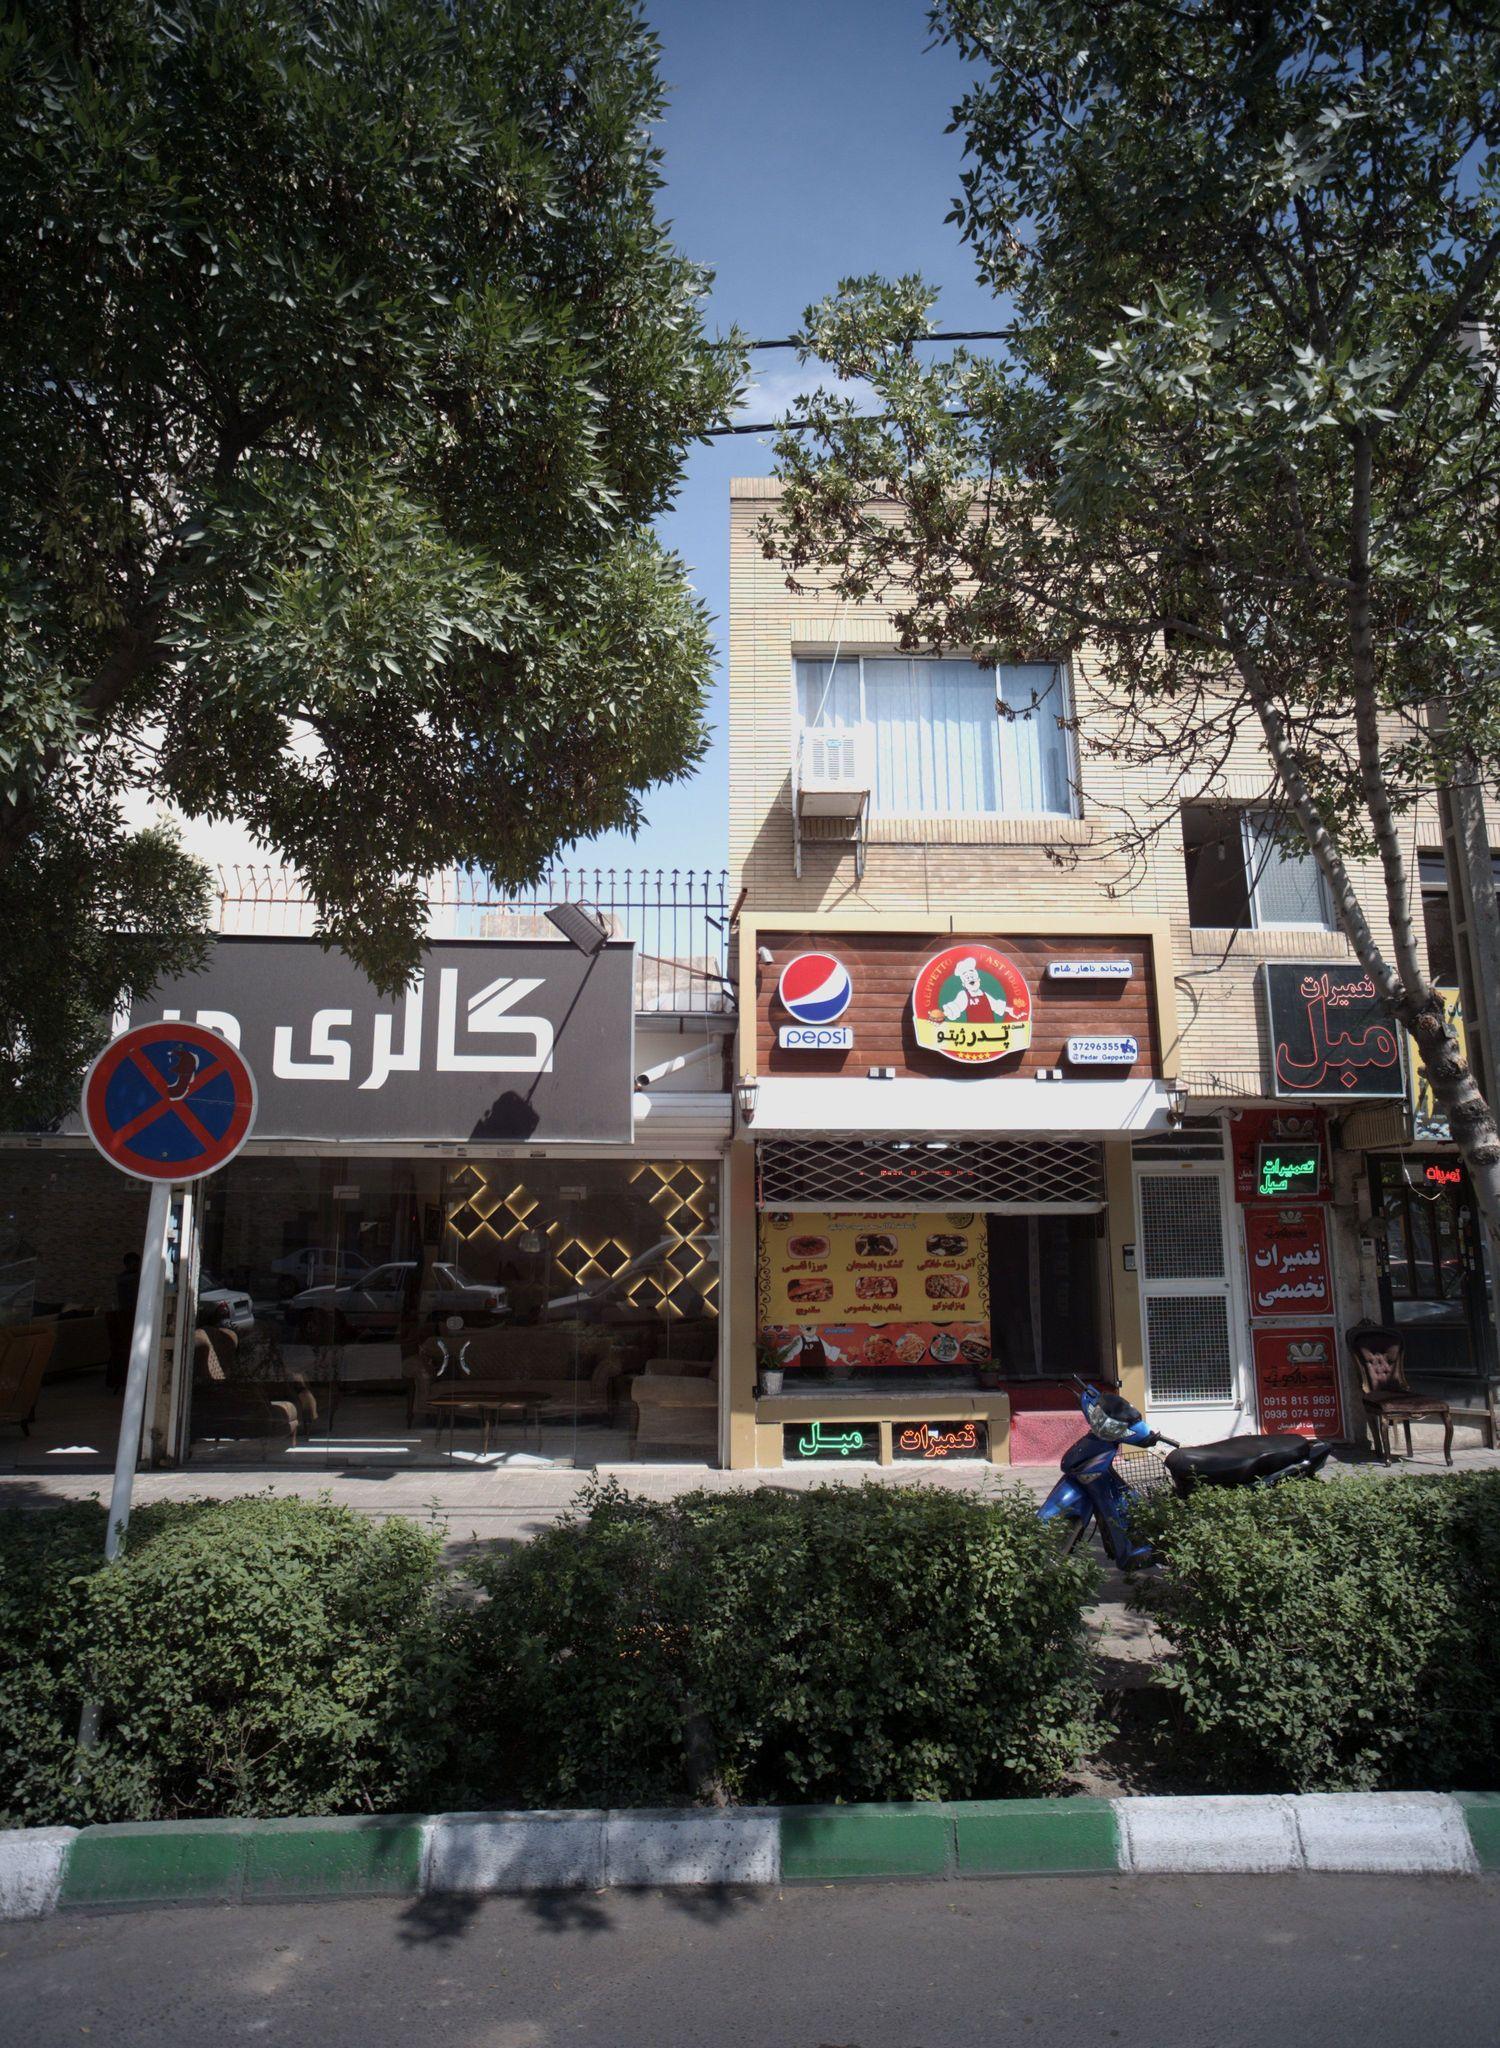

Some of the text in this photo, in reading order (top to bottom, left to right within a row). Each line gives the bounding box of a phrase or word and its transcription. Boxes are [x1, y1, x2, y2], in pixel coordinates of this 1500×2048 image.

[1054, 963, 1071, 974] شام
[1100, 964, 1130, 975] صبحانه
[272, 967, 555, 1090] گالری
[786, 1028, 848, 1049] pepsi
[1073, 1042, 1120, 1051] 37296355
[1276, 994, 1397, 1089] مبل
[1263, 1158, 1315, 1178] تعمیرات
[1426, 1165, 1462, 1184] تعمیرات
[1259, 1174, 1289, 1195] مبل
[1254, 1242, 1321, 1274] تعمیرات
[1258, 1273, 1326, 1308] تخصصی
[1263, 1395, 1336, 1406] 0915 815 9691
[1264, 1408, 1336, 1419] 0936 074 9787
[799, 1421, 863, 1456] مبل
[900, 1424, 977, 1458] تعمیرات
